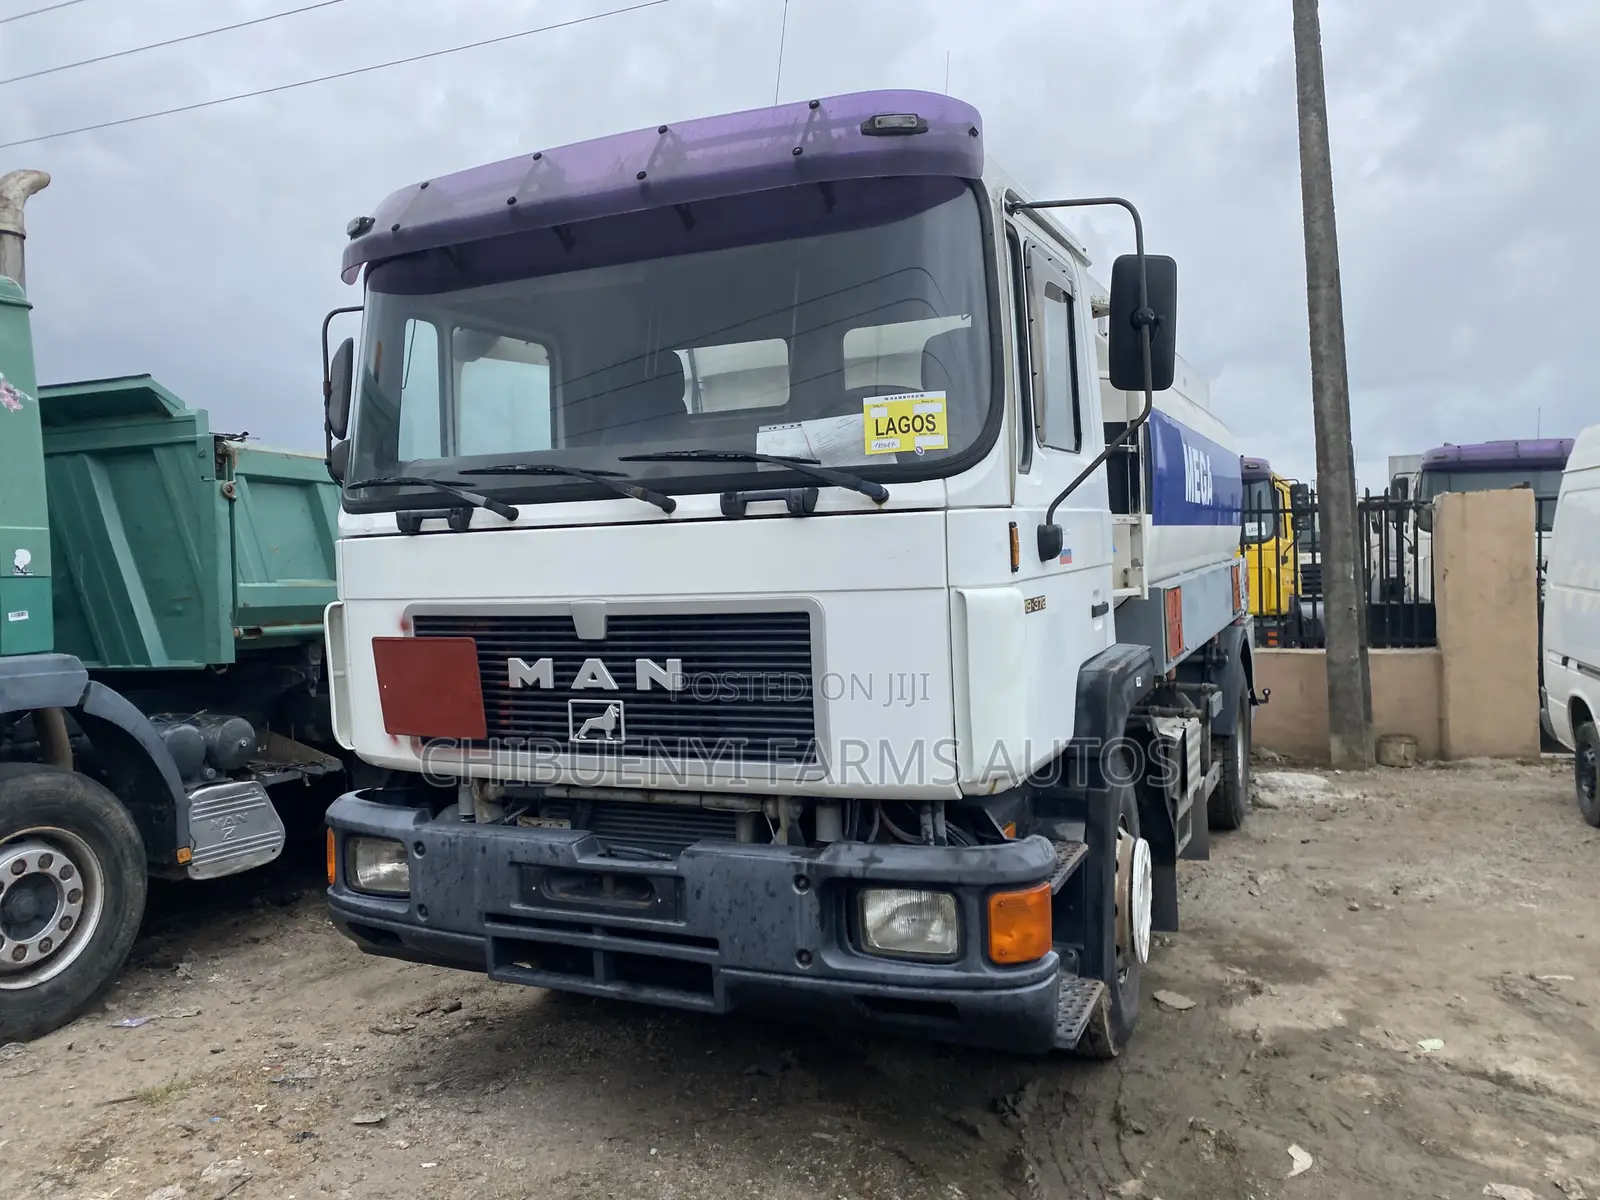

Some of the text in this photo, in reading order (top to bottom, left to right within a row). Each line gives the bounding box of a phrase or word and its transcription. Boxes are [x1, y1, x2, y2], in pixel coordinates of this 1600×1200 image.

[875, 414, 936, 436] LAGOS
[1183, 443, 1213, 506] MEGA
[507, 657, 683, 691] MAN
